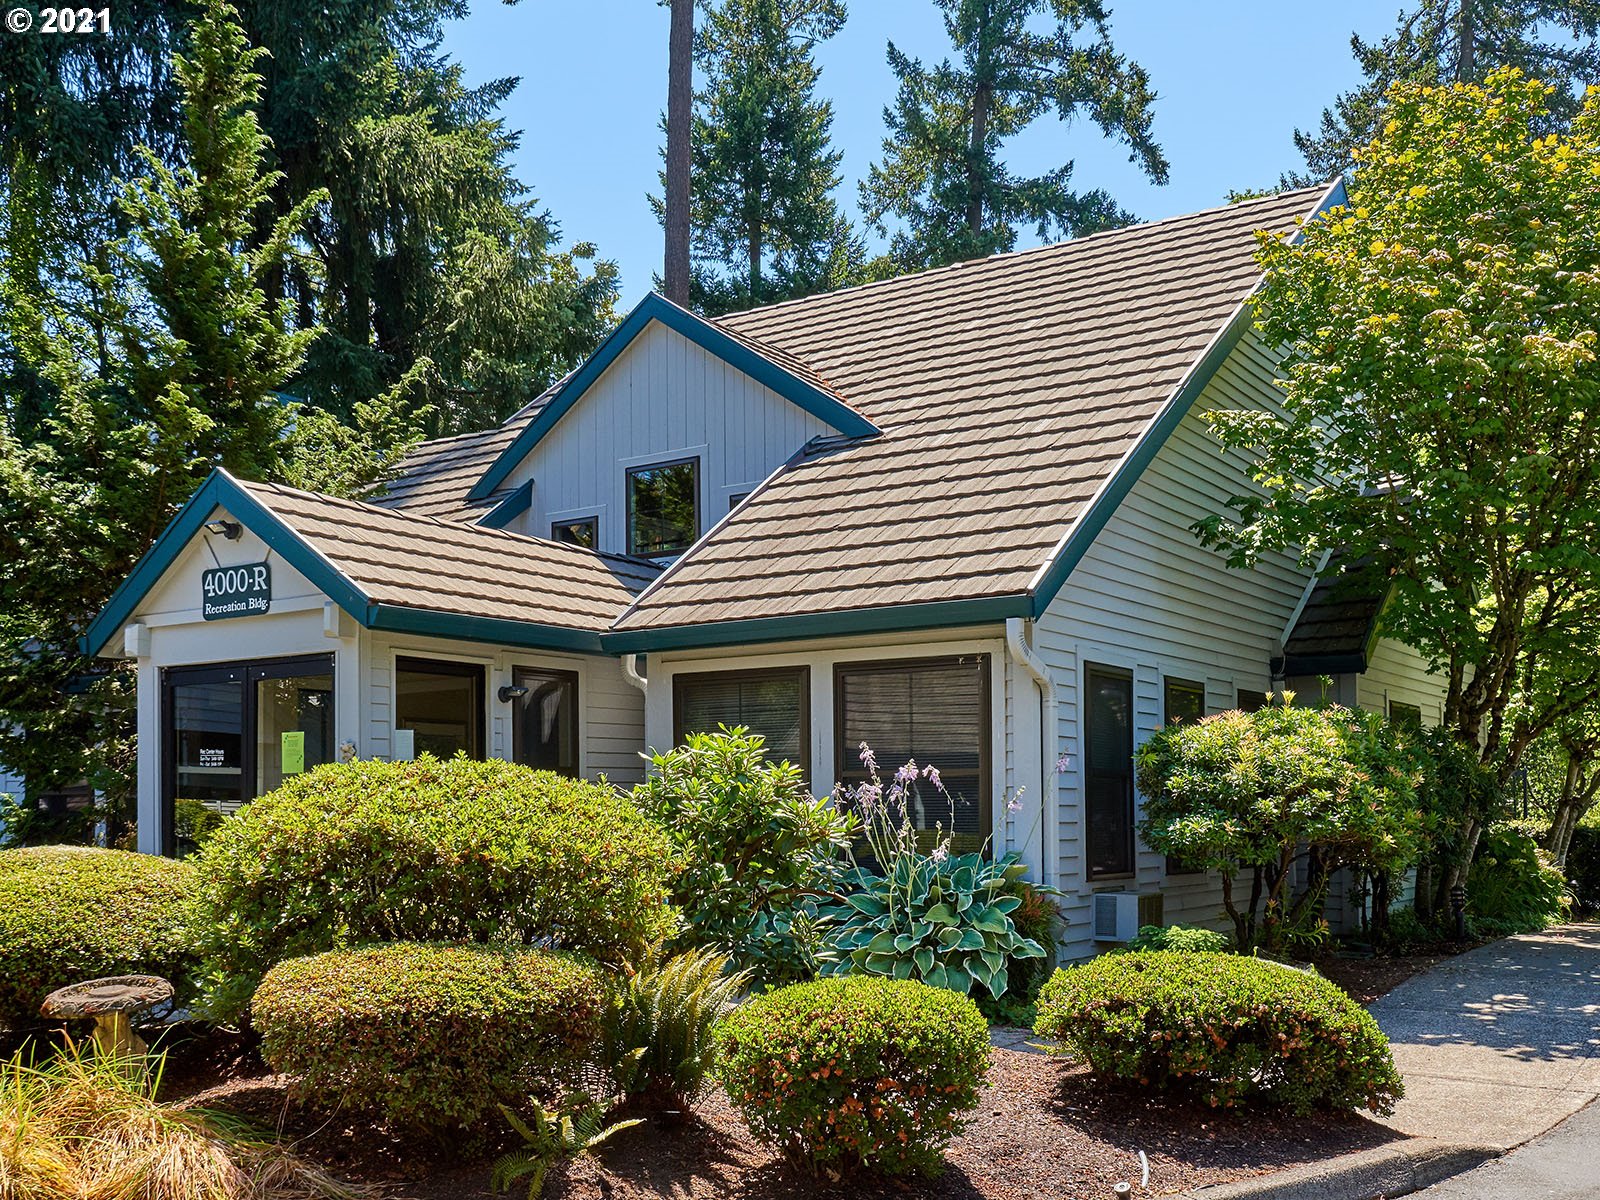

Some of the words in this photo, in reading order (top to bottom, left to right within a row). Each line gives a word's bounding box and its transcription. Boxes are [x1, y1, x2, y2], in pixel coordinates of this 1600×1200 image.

[204, 566, 268, 597] 4000-R
[205, 600, 247, 615] Recreation
[248, 597, 269, 611] Bldg.
